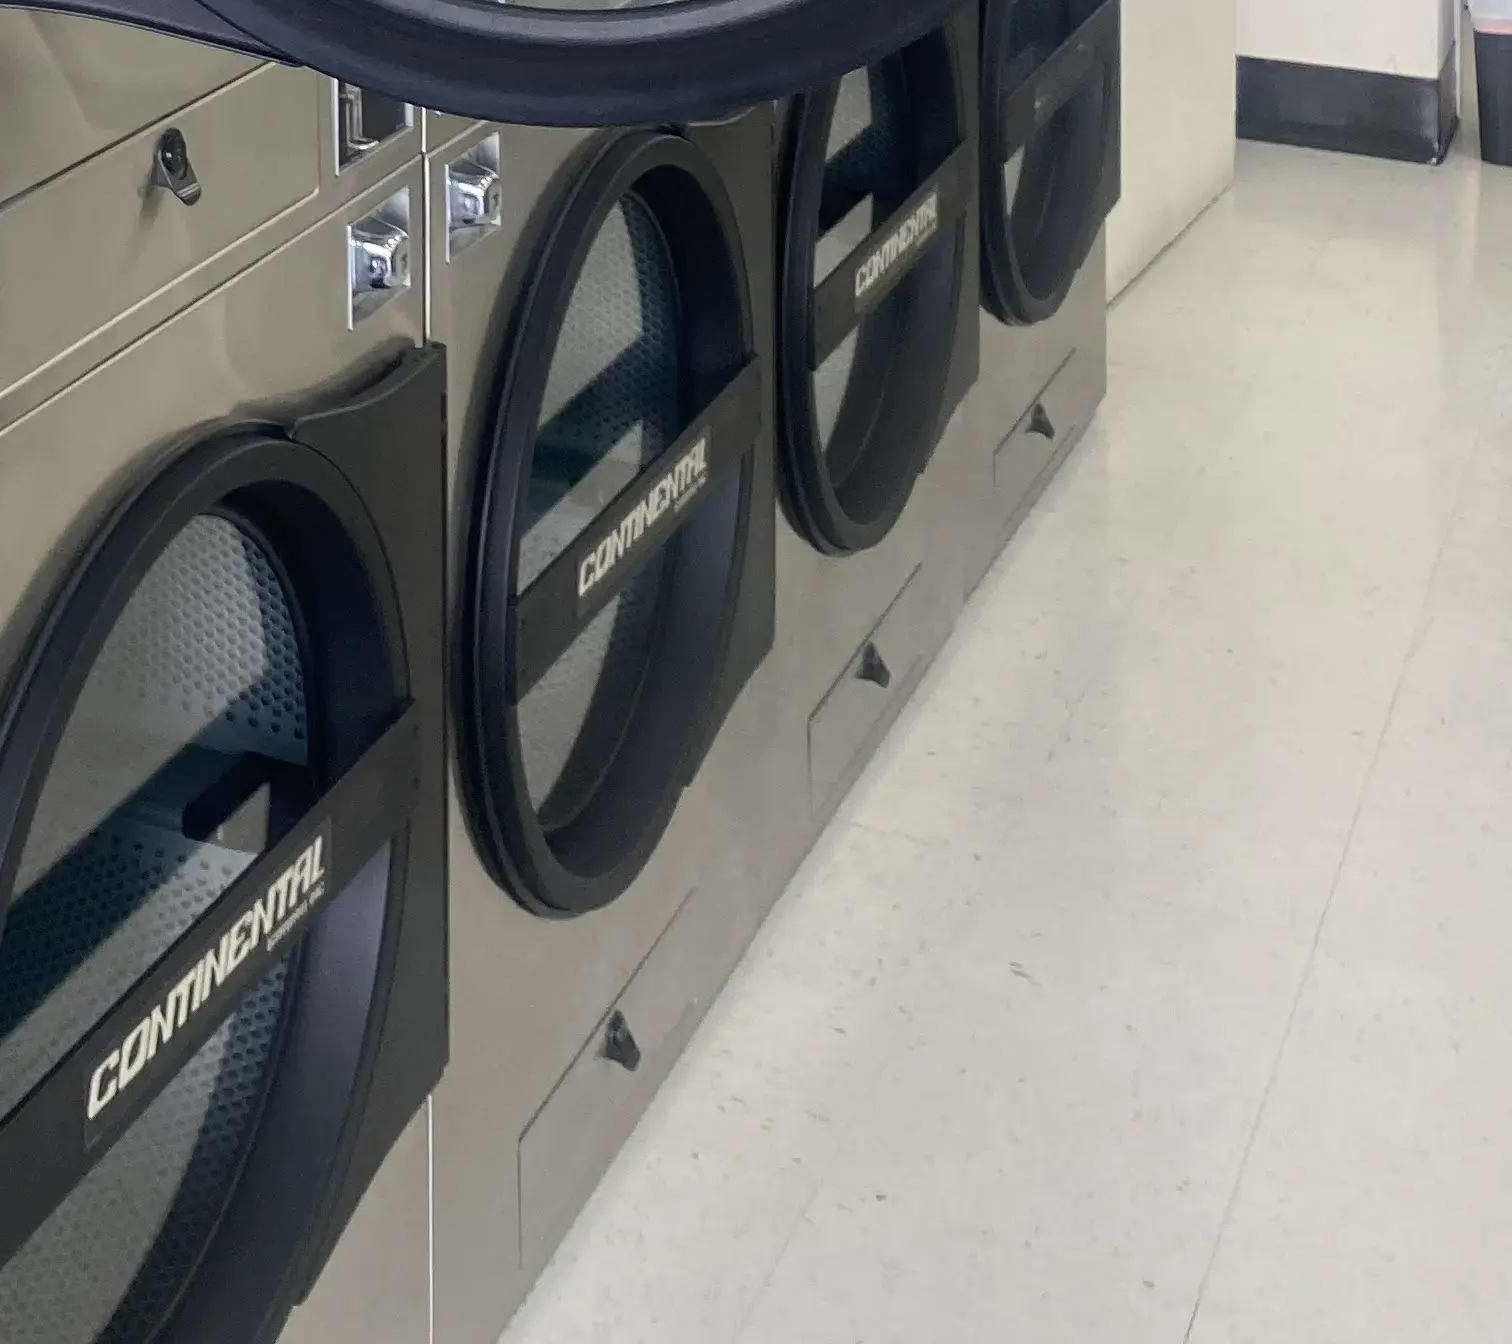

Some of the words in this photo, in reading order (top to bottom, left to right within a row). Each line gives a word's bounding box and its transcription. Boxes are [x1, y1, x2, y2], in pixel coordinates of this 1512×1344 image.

[854, 191, 938, 297] CONTINENTAL
[577, 436, 708, 597] CONTINENTAL
[87, 834, 325, 1121] CONTINENTAL
